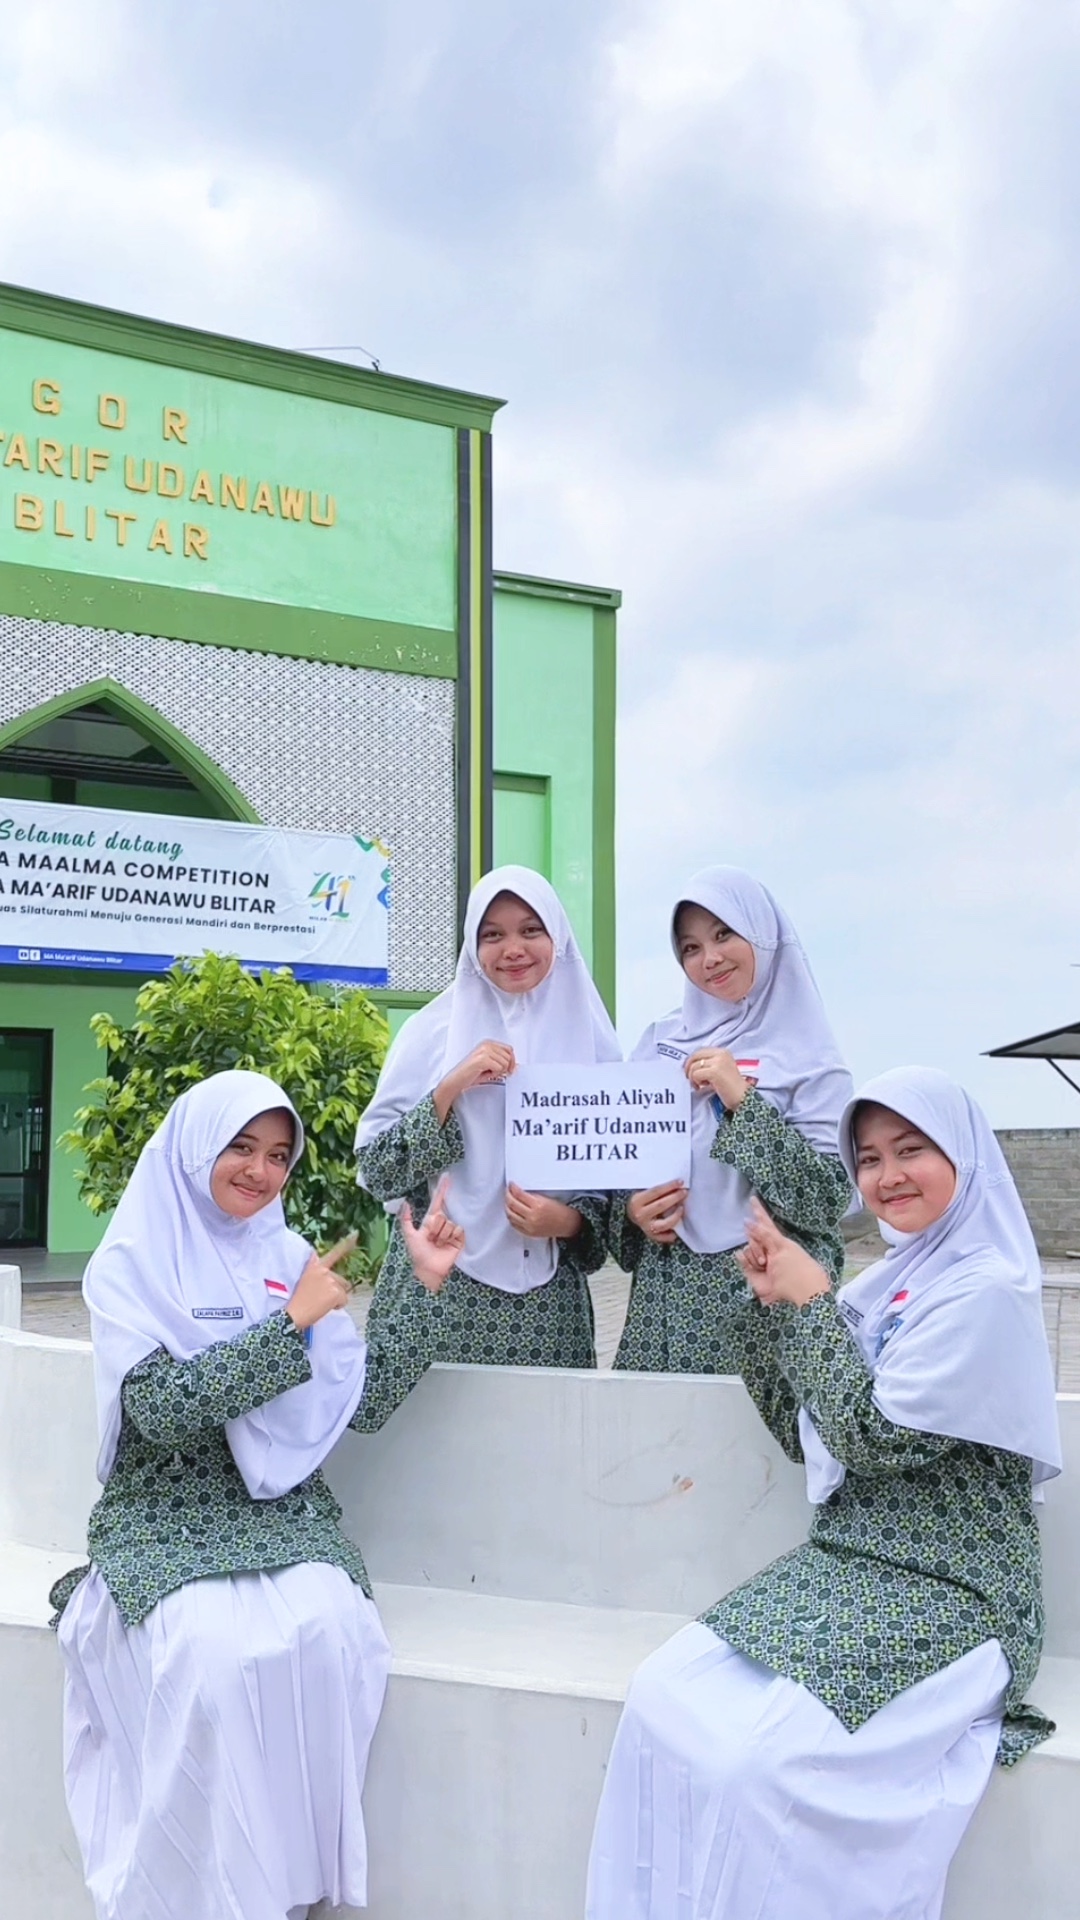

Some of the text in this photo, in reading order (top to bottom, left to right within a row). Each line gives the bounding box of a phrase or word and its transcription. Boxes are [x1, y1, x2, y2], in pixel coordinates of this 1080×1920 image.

[0, 432, 337, 527] ARIF UDANAWU
[15, 492, 209, 560] BLITAR
[0, 818, 184, 861] Selamat datang
[18, 852, 117, 877] MAALMA
[123, 861, 270, 889] COMPETITION
[101, 885, 206, 909] UDANAWU
[210, 894, 277, 915] BLITAR
[20, 904, 88, 919] Silaturahmi
[90, 909, 132, 923] Menuju
[134, 913, 183, 926] Generasi
[186, 917, 228, 929] Mandiri
[230, 920, 251, 930] dan
[253, 922, 316, 935] Berprestasi
[521, 1089, 675, 1109] Madrasah Aliyah
[594, 1116, 687, 1135] Udanawu
[556, 1143, 639, 1161] BLITAR
